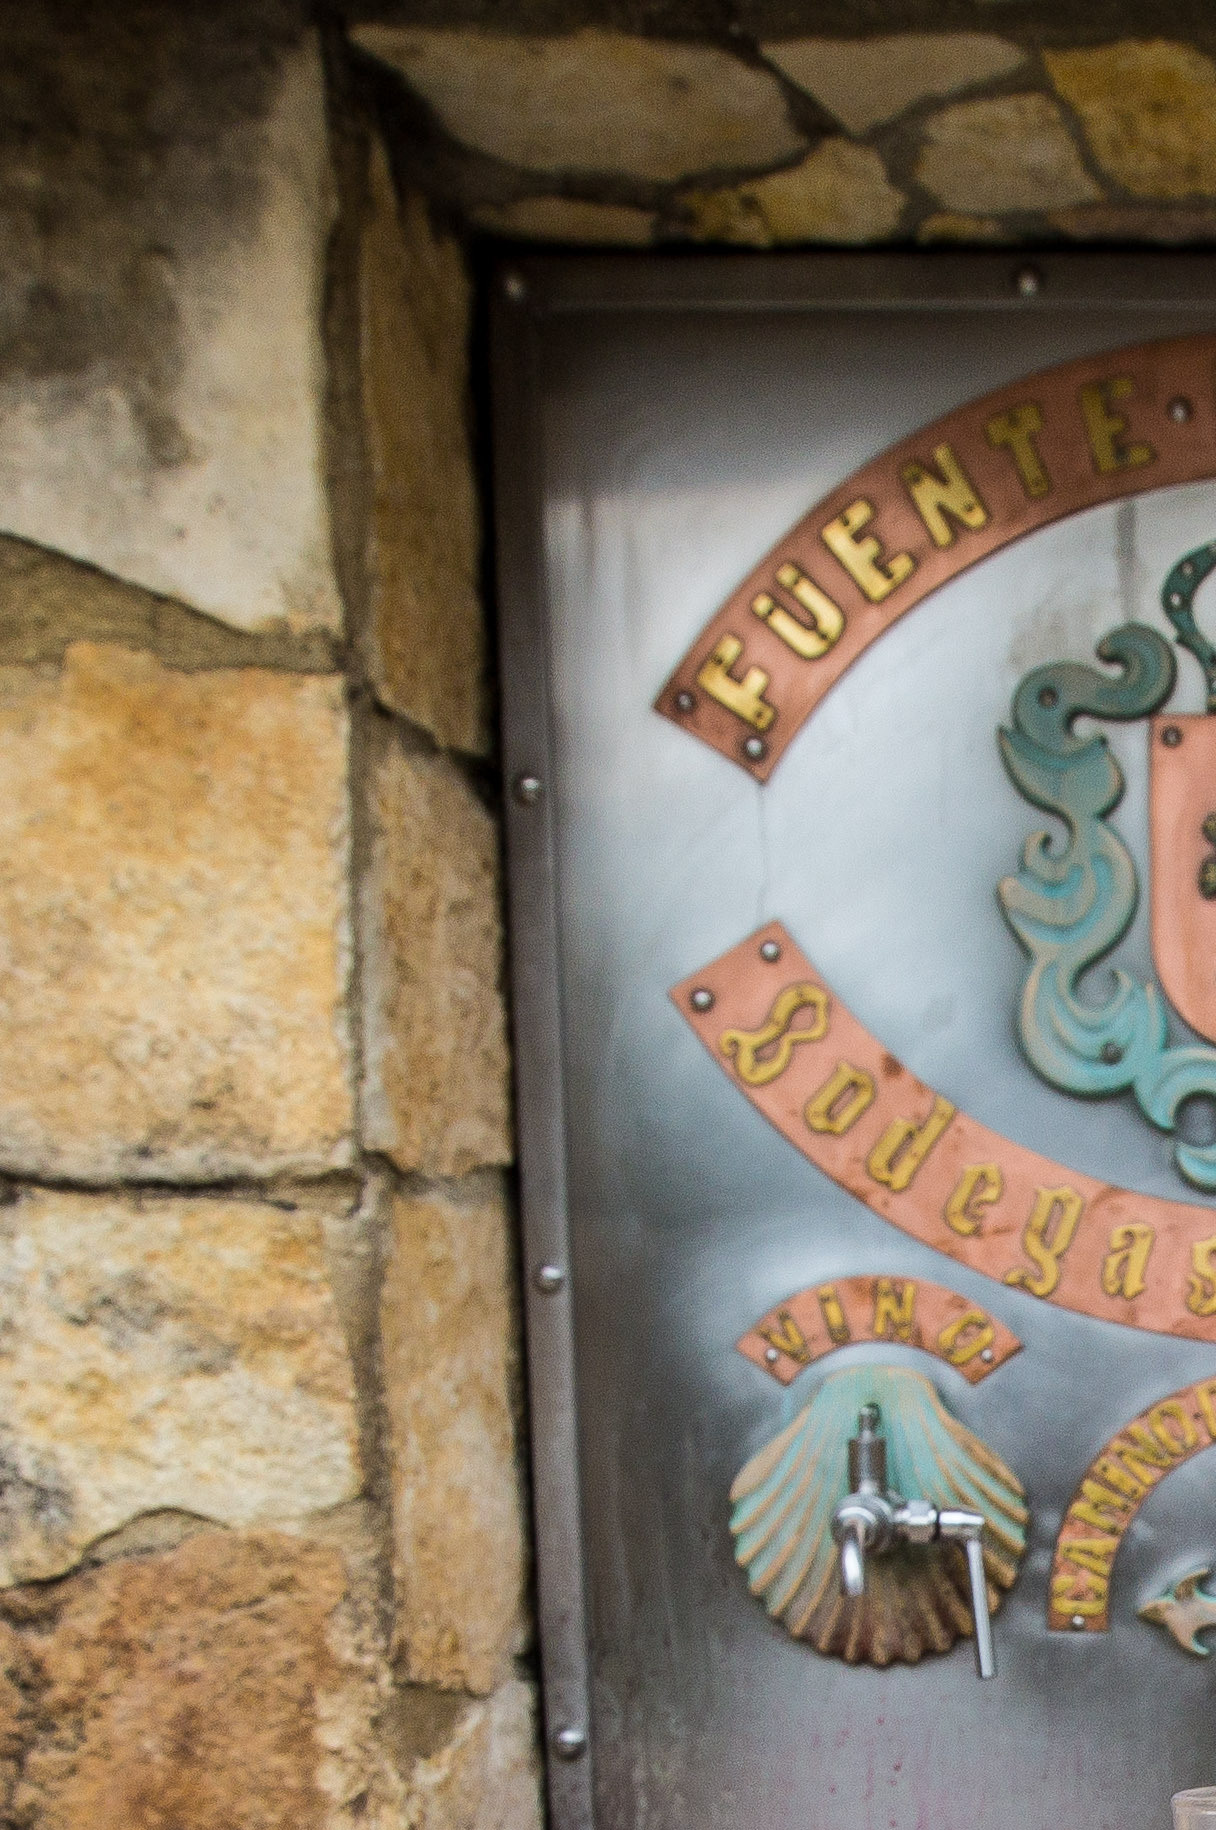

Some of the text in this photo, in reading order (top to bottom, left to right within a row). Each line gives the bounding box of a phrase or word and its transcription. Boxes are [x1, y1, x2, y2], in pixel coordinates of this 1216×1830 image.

[700, 378, 1156, 731] FUENTE
[759, 1279, 994, 1364] VINO
[1052, 1399, 1199, 1616] CAMINO
